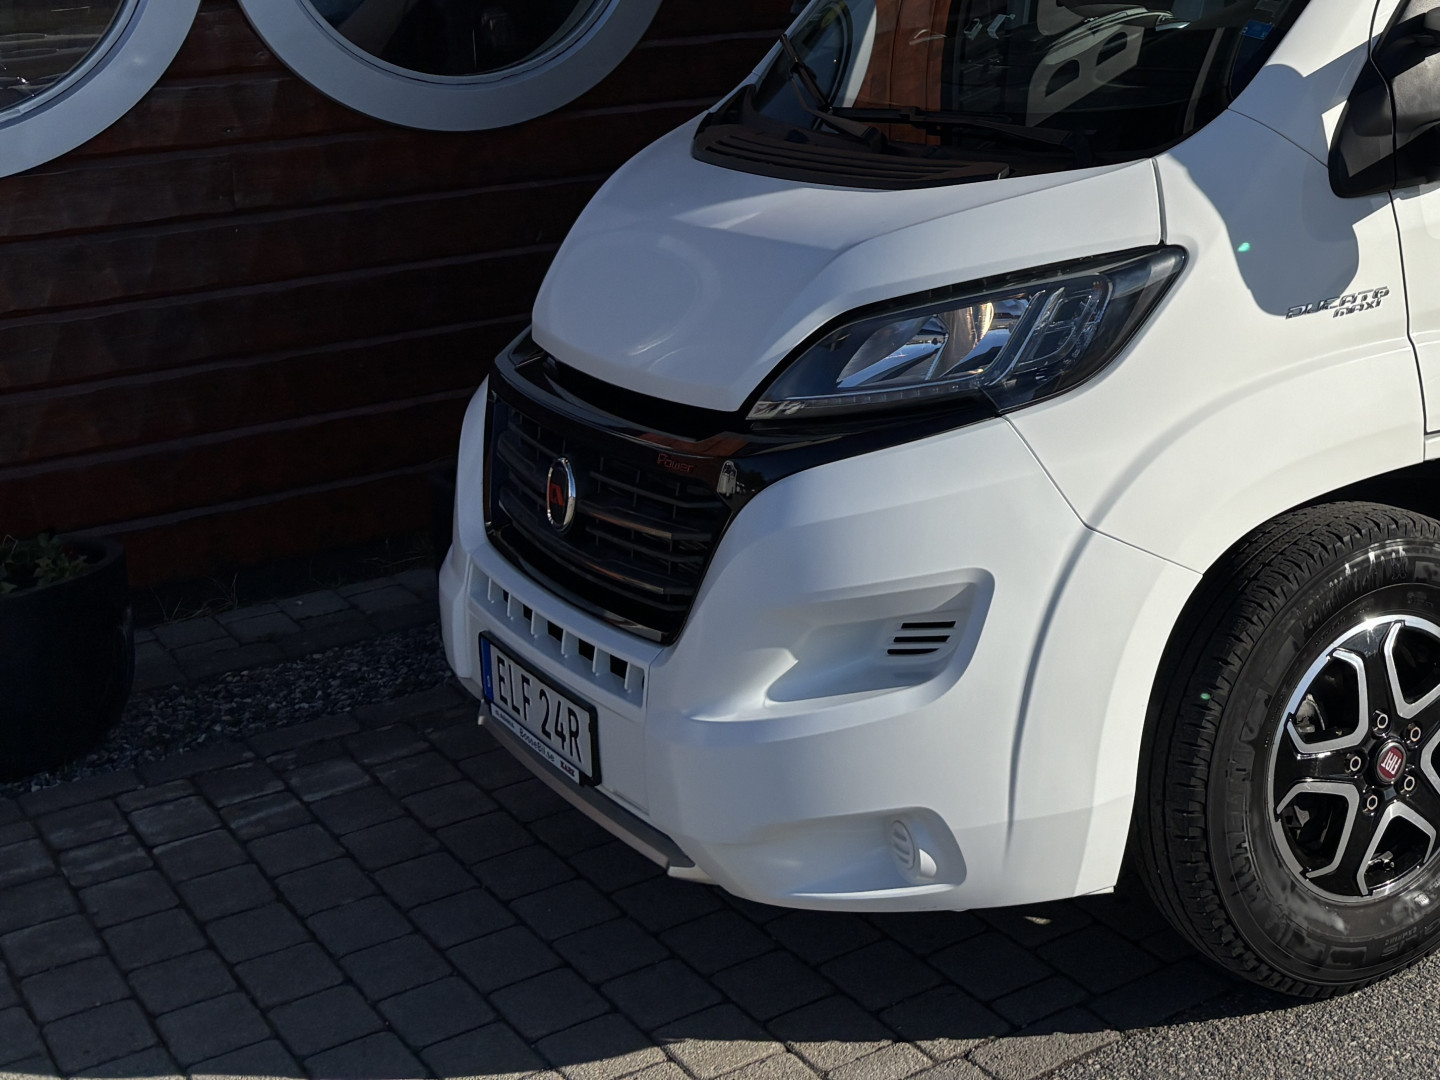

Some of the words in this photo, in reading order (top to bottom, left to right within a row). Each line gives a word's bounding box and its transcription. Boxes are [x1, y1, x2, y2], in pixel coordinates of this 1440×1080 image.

[496, 654, 532, 721] ELF
[539, 688, 582, 763] 24R
[1381, 751, 1402, 775] FIAT
